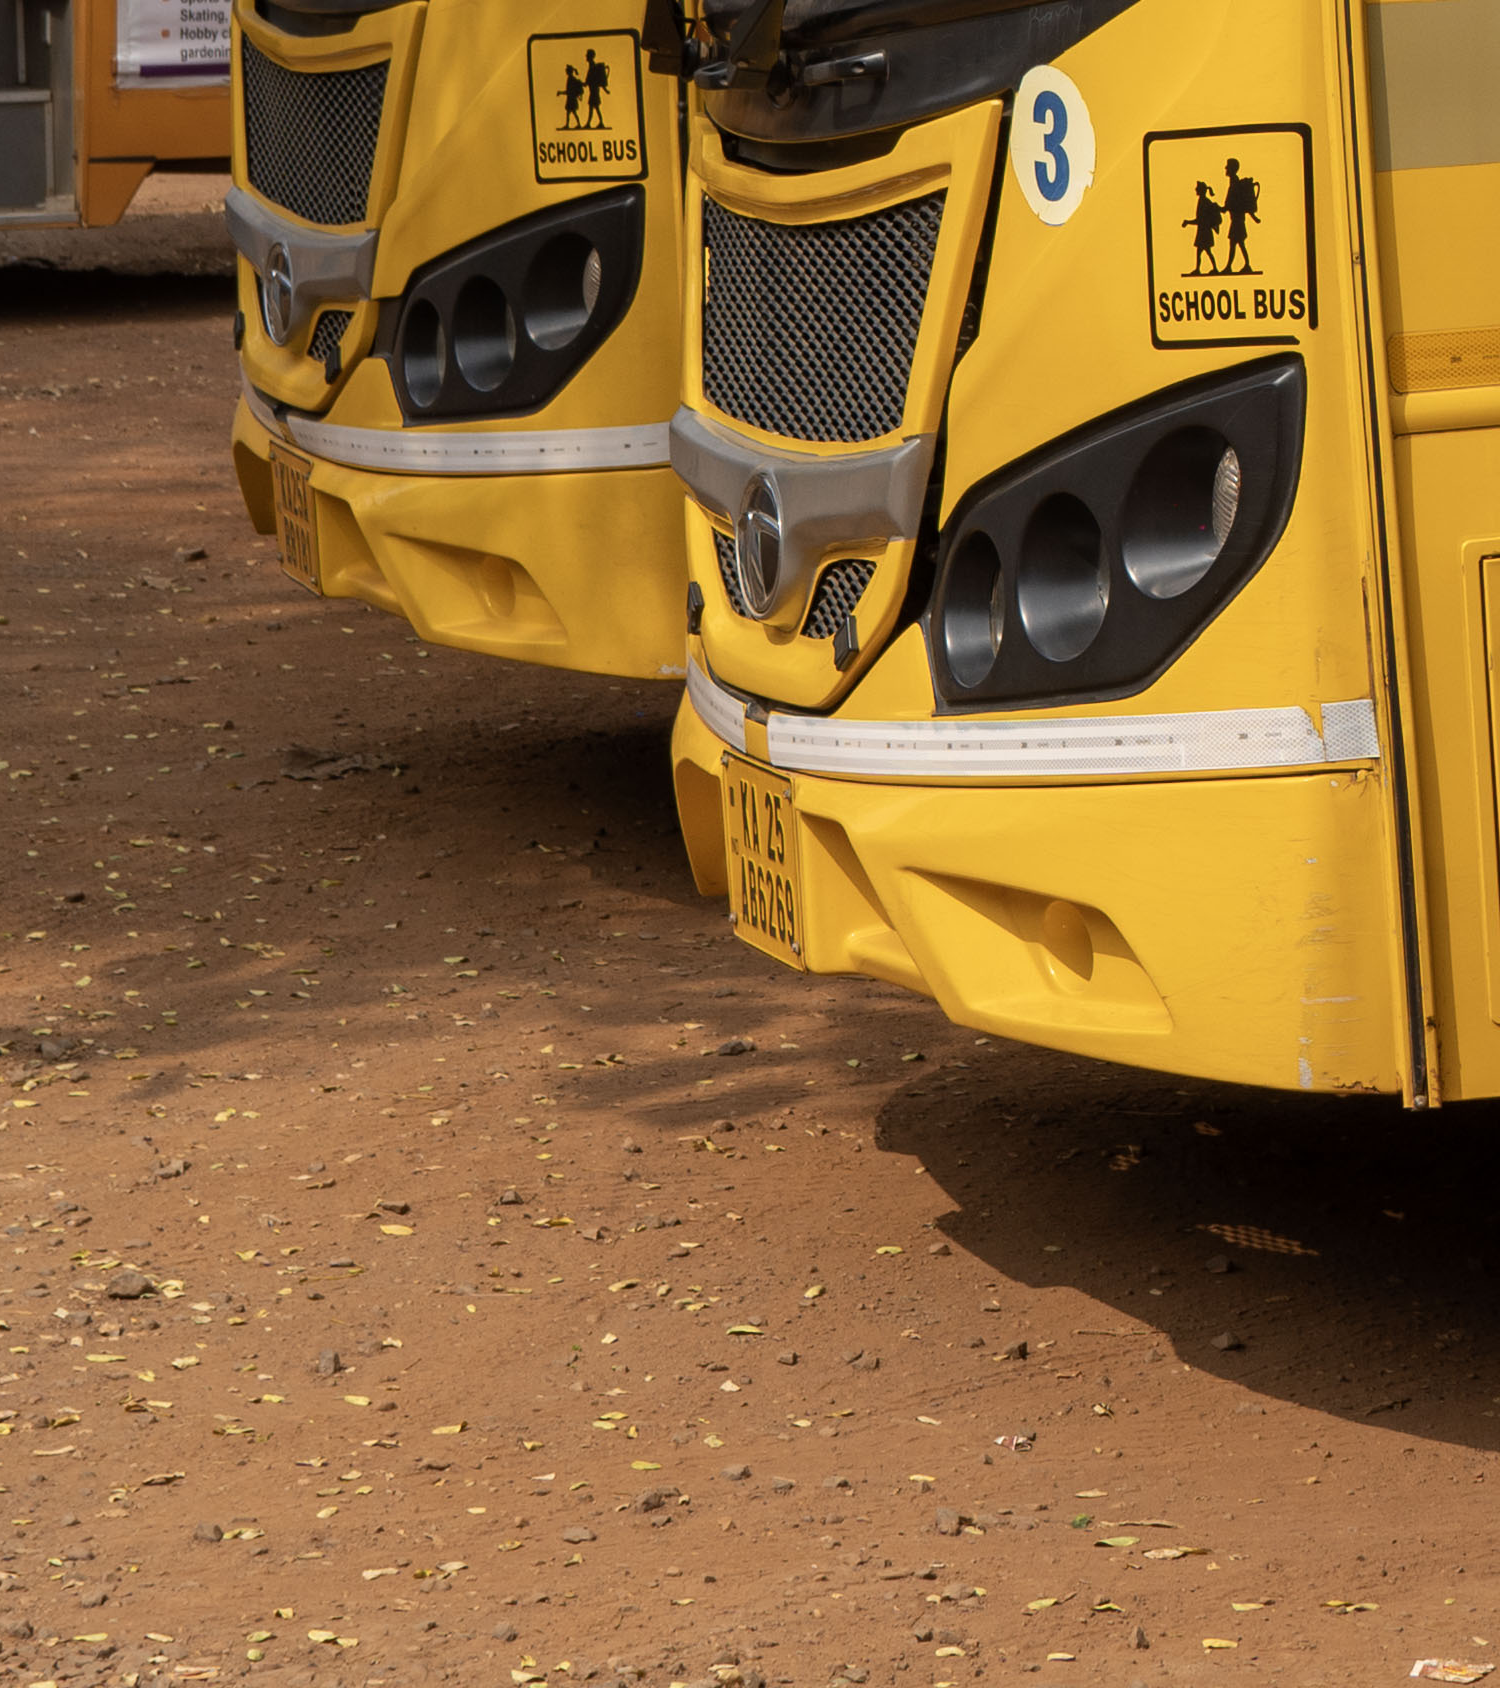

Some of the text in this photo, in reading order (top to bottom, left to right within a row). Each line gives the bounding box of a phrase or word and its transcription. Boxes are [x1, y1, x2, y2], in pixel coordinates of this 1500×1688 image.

[180, 27, 218, 42] Hobby
[539, 138, 637, 164] SCHOOL BUS
[1032, 91, 1070, 201] 3
[1158, 286, 1305, 321] SCHOOL BUS
[740, 780, 784, 864] KA 25
[741, 856, 795, 947] AB6269
